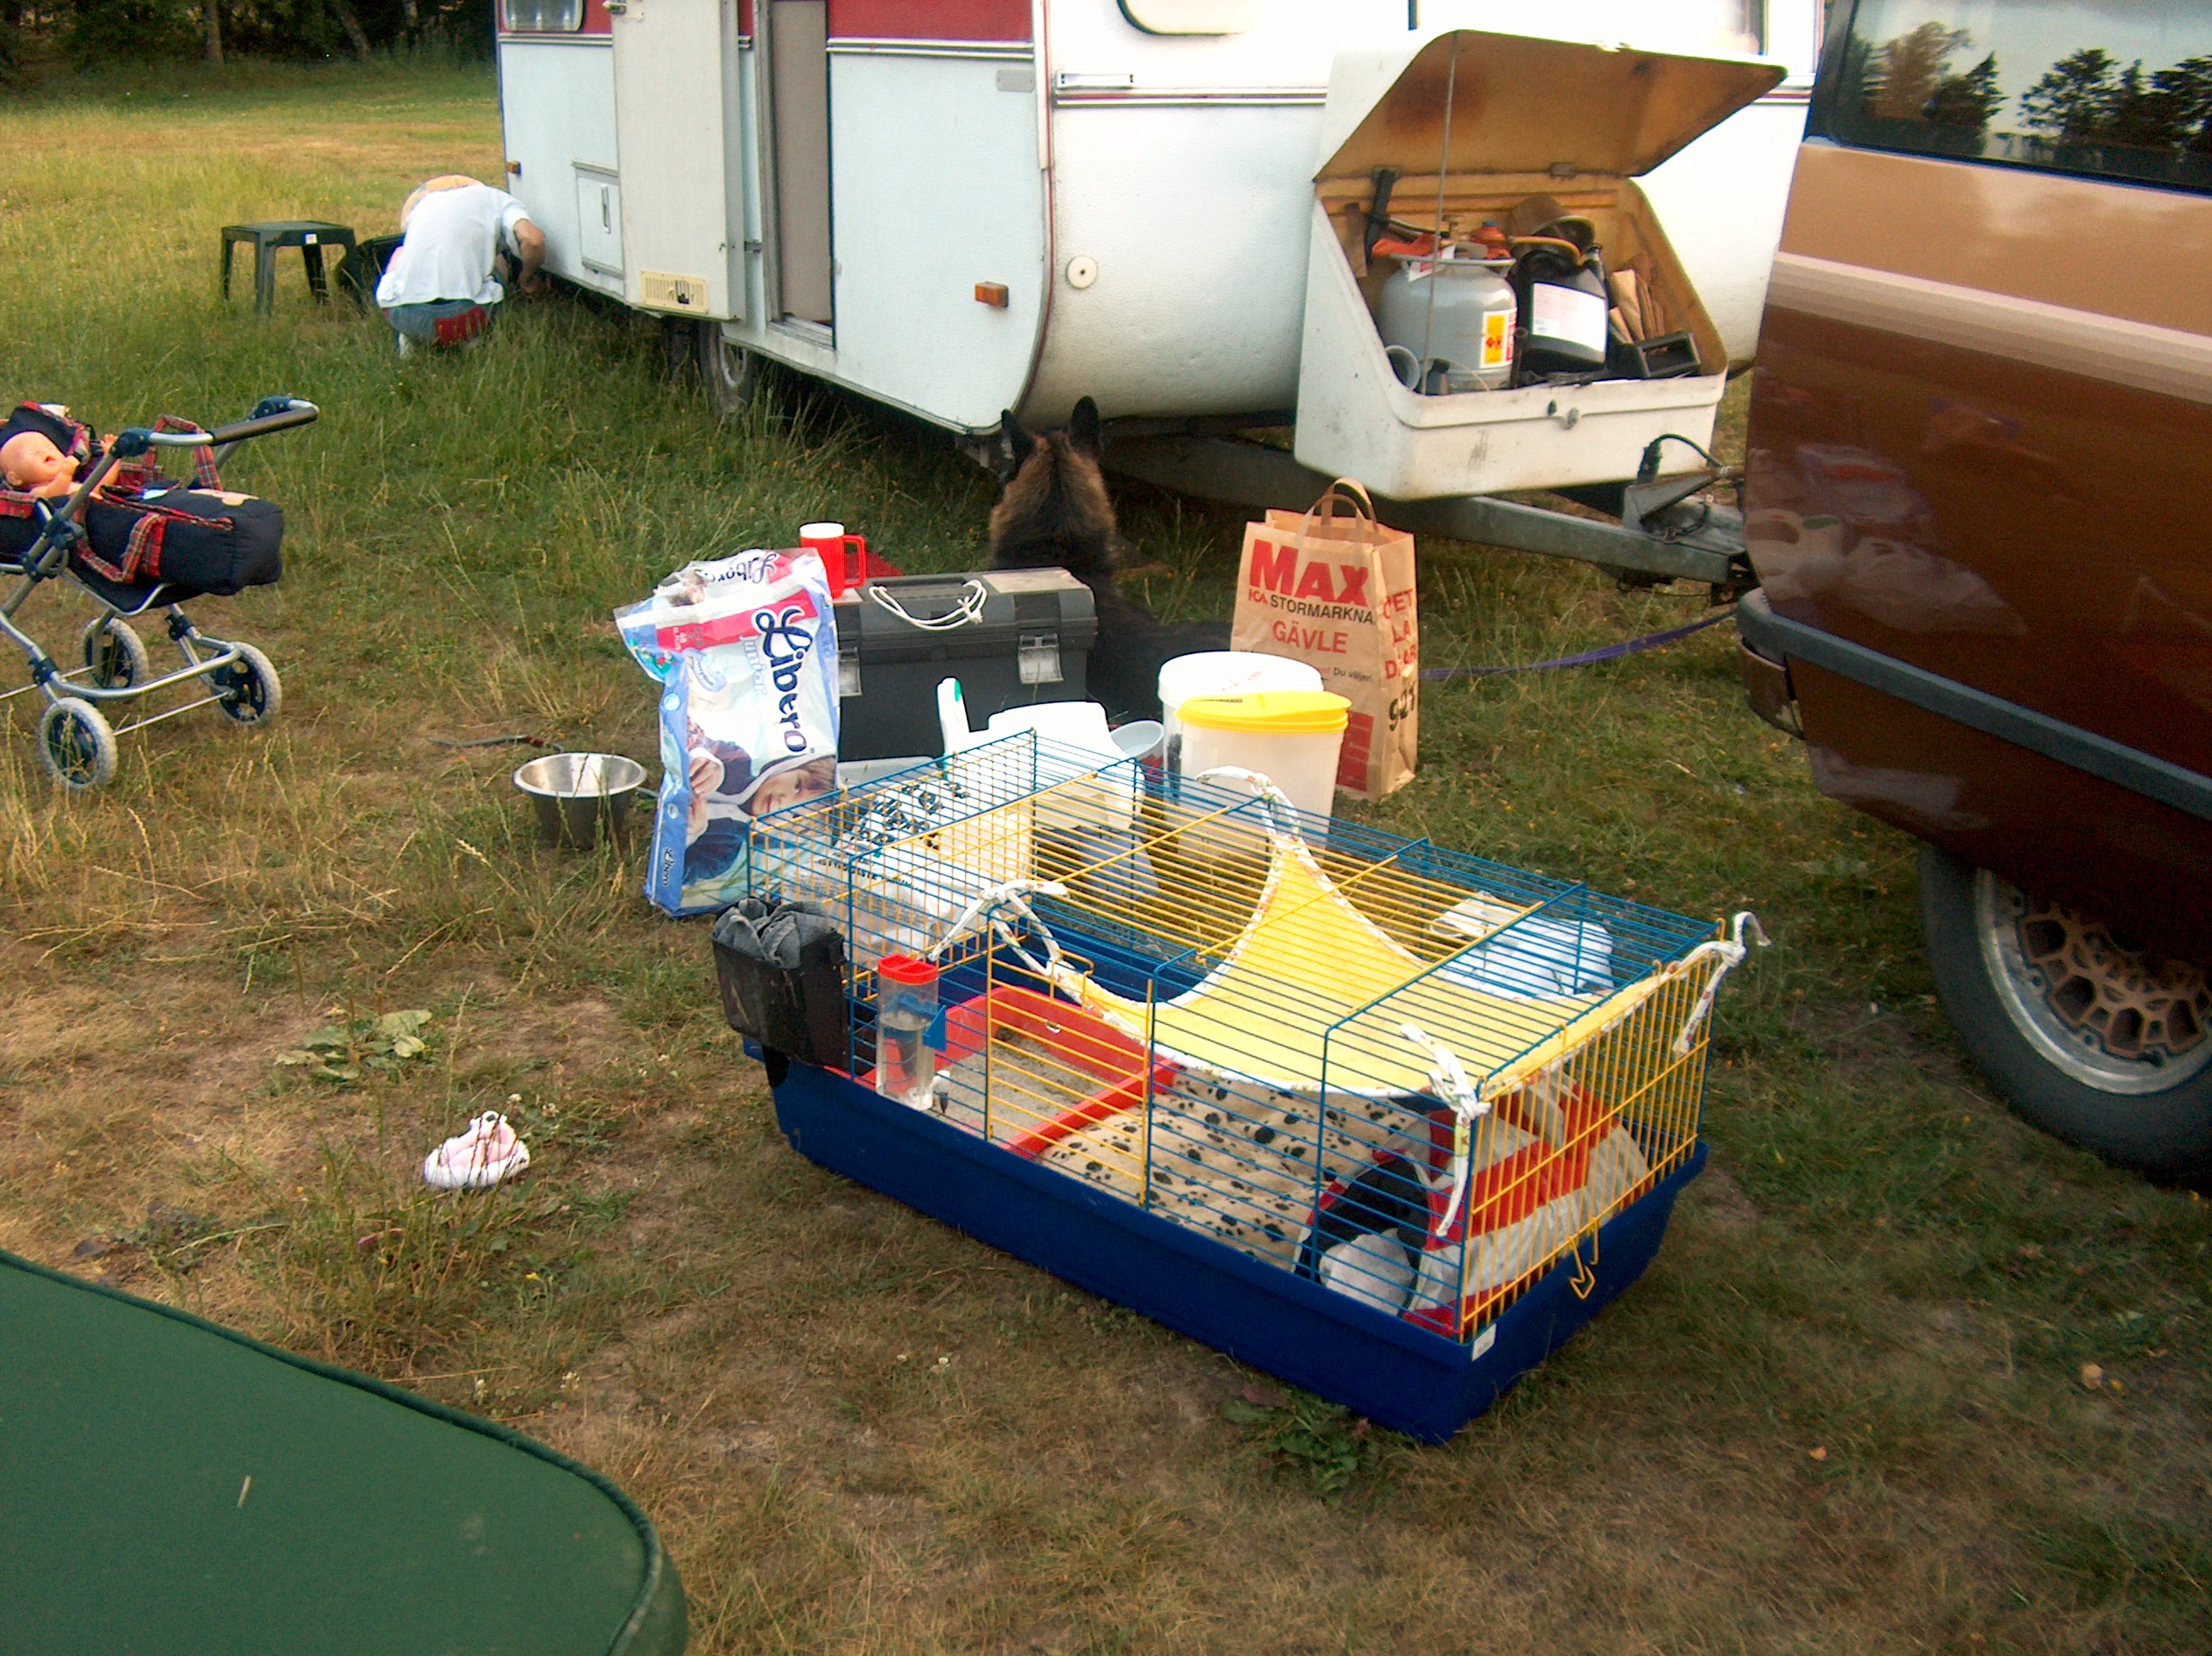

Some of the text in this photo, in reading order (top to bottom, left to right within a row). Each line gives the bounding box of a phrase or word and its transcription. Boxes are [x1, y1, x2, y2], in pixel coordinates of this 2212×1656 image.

[1249, 538, 1369, 607] MAX
[1271, 593, 1377, 625] STORMARKNA
[1272, 619, 1349, 654] GÄVLE
[755, 607, 813, 753] Libero
